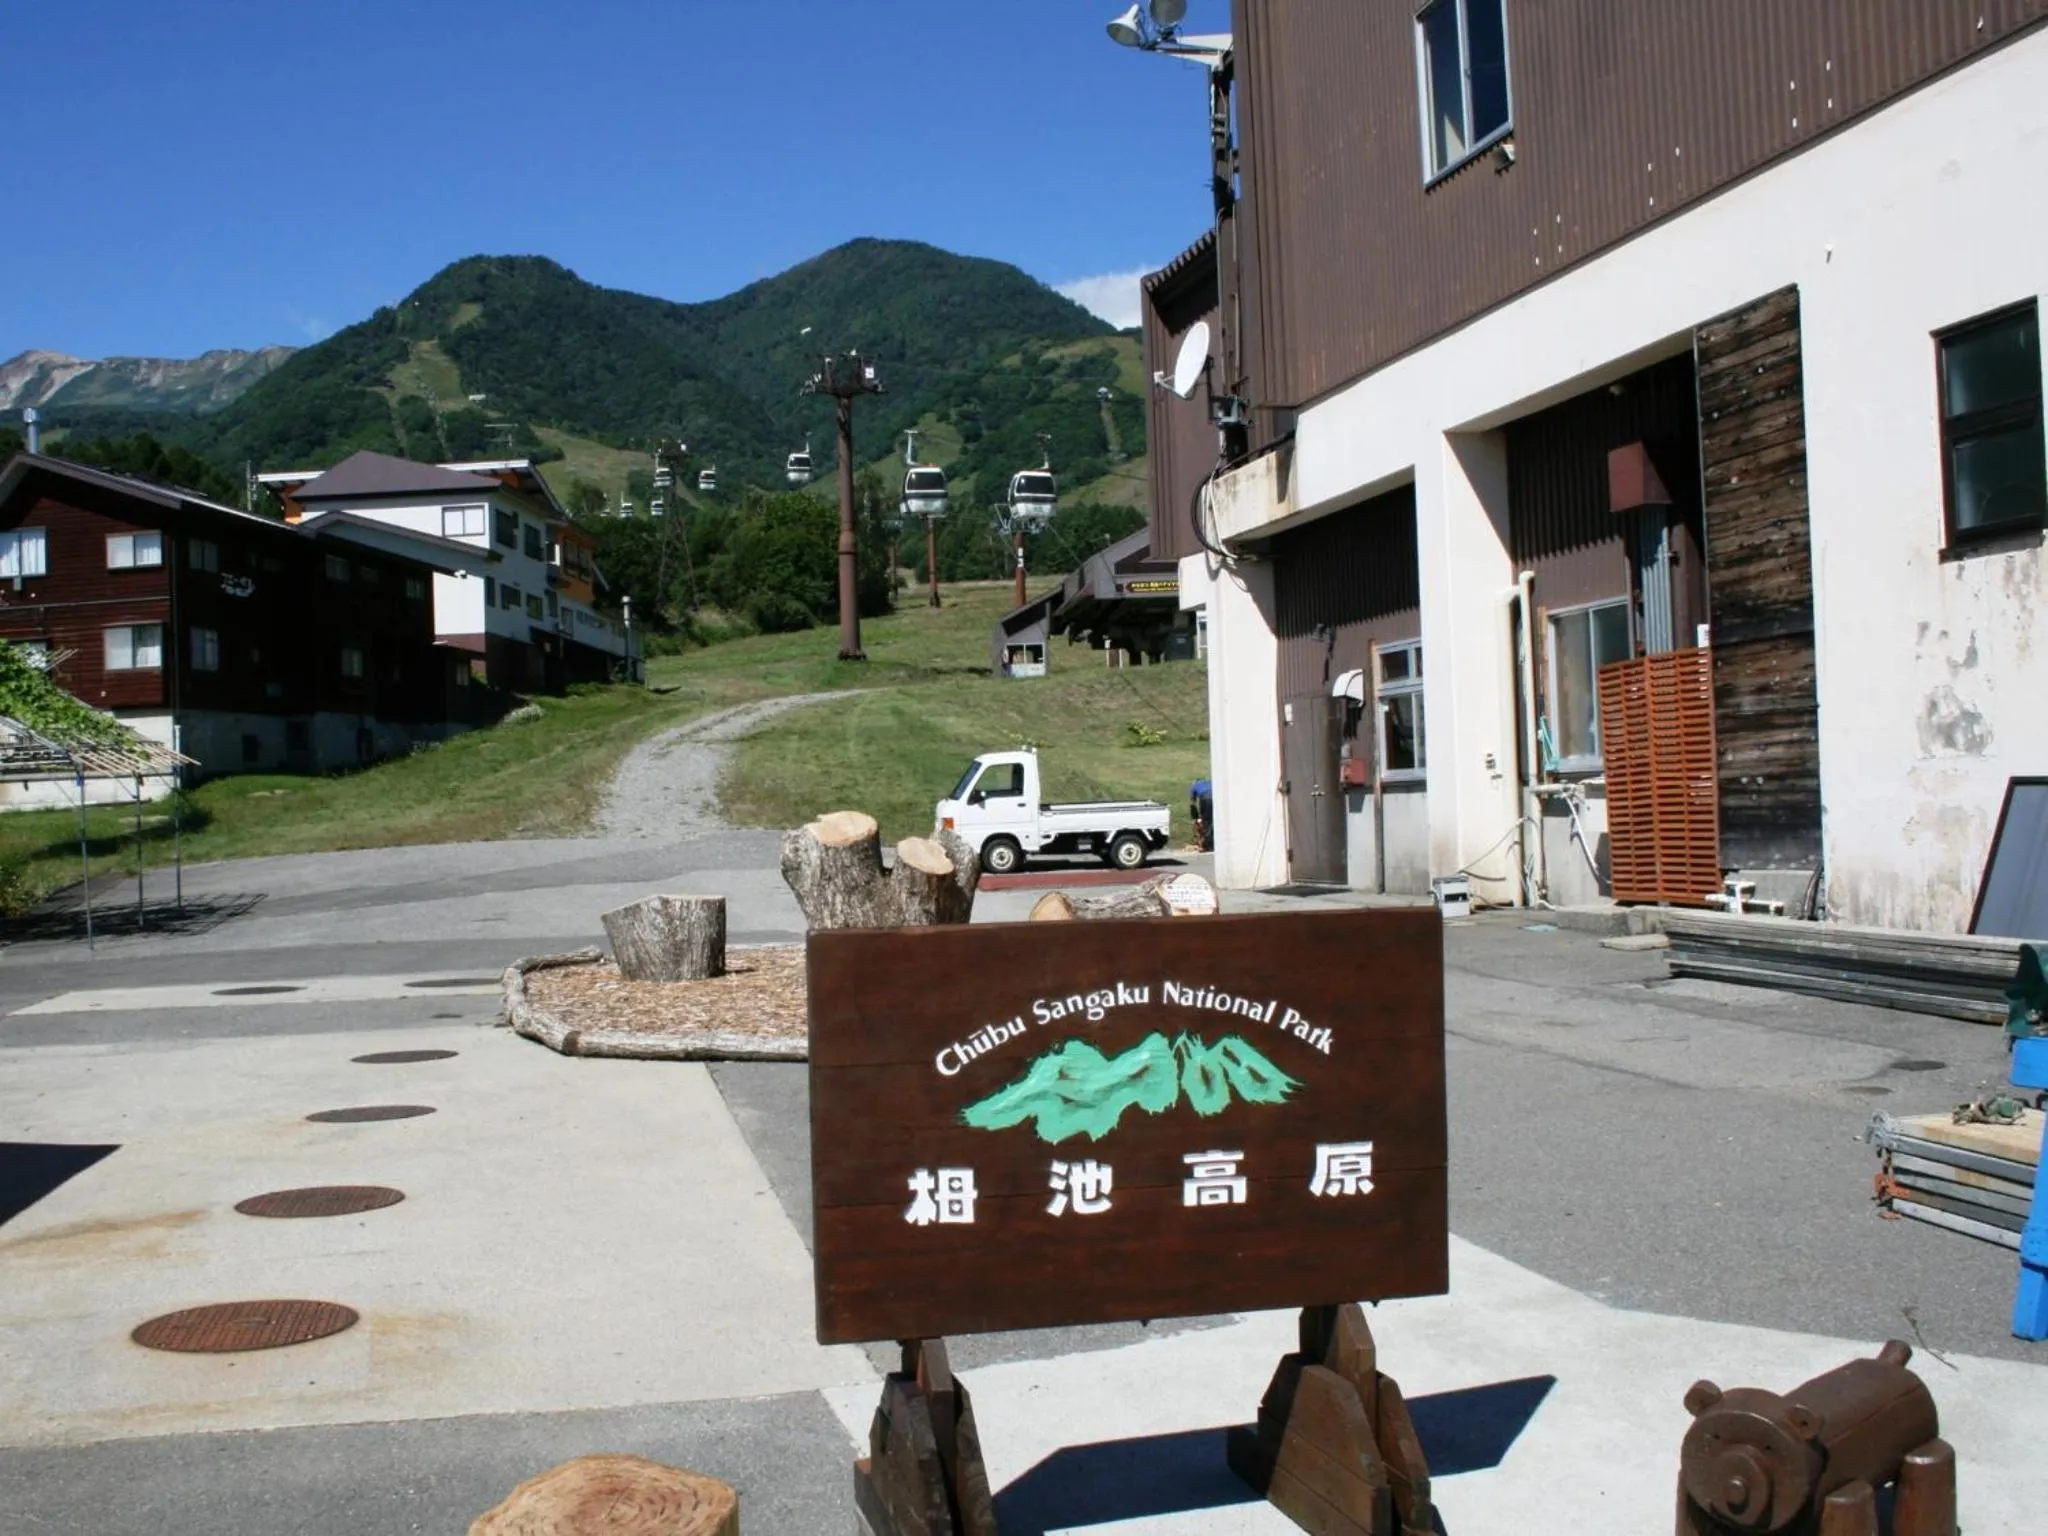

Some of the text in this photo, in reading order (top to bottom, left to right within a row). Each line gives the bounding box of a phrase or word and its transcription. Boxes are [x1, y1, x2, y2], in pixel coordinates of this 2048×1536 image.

[1033, 981, 1150, 1025] Sangaku
[1163, 981, 1277, 1024] National
[1279, 1007, 1333, 1055] Park
[904, 1141, 1375, 1226] 栂池高原
